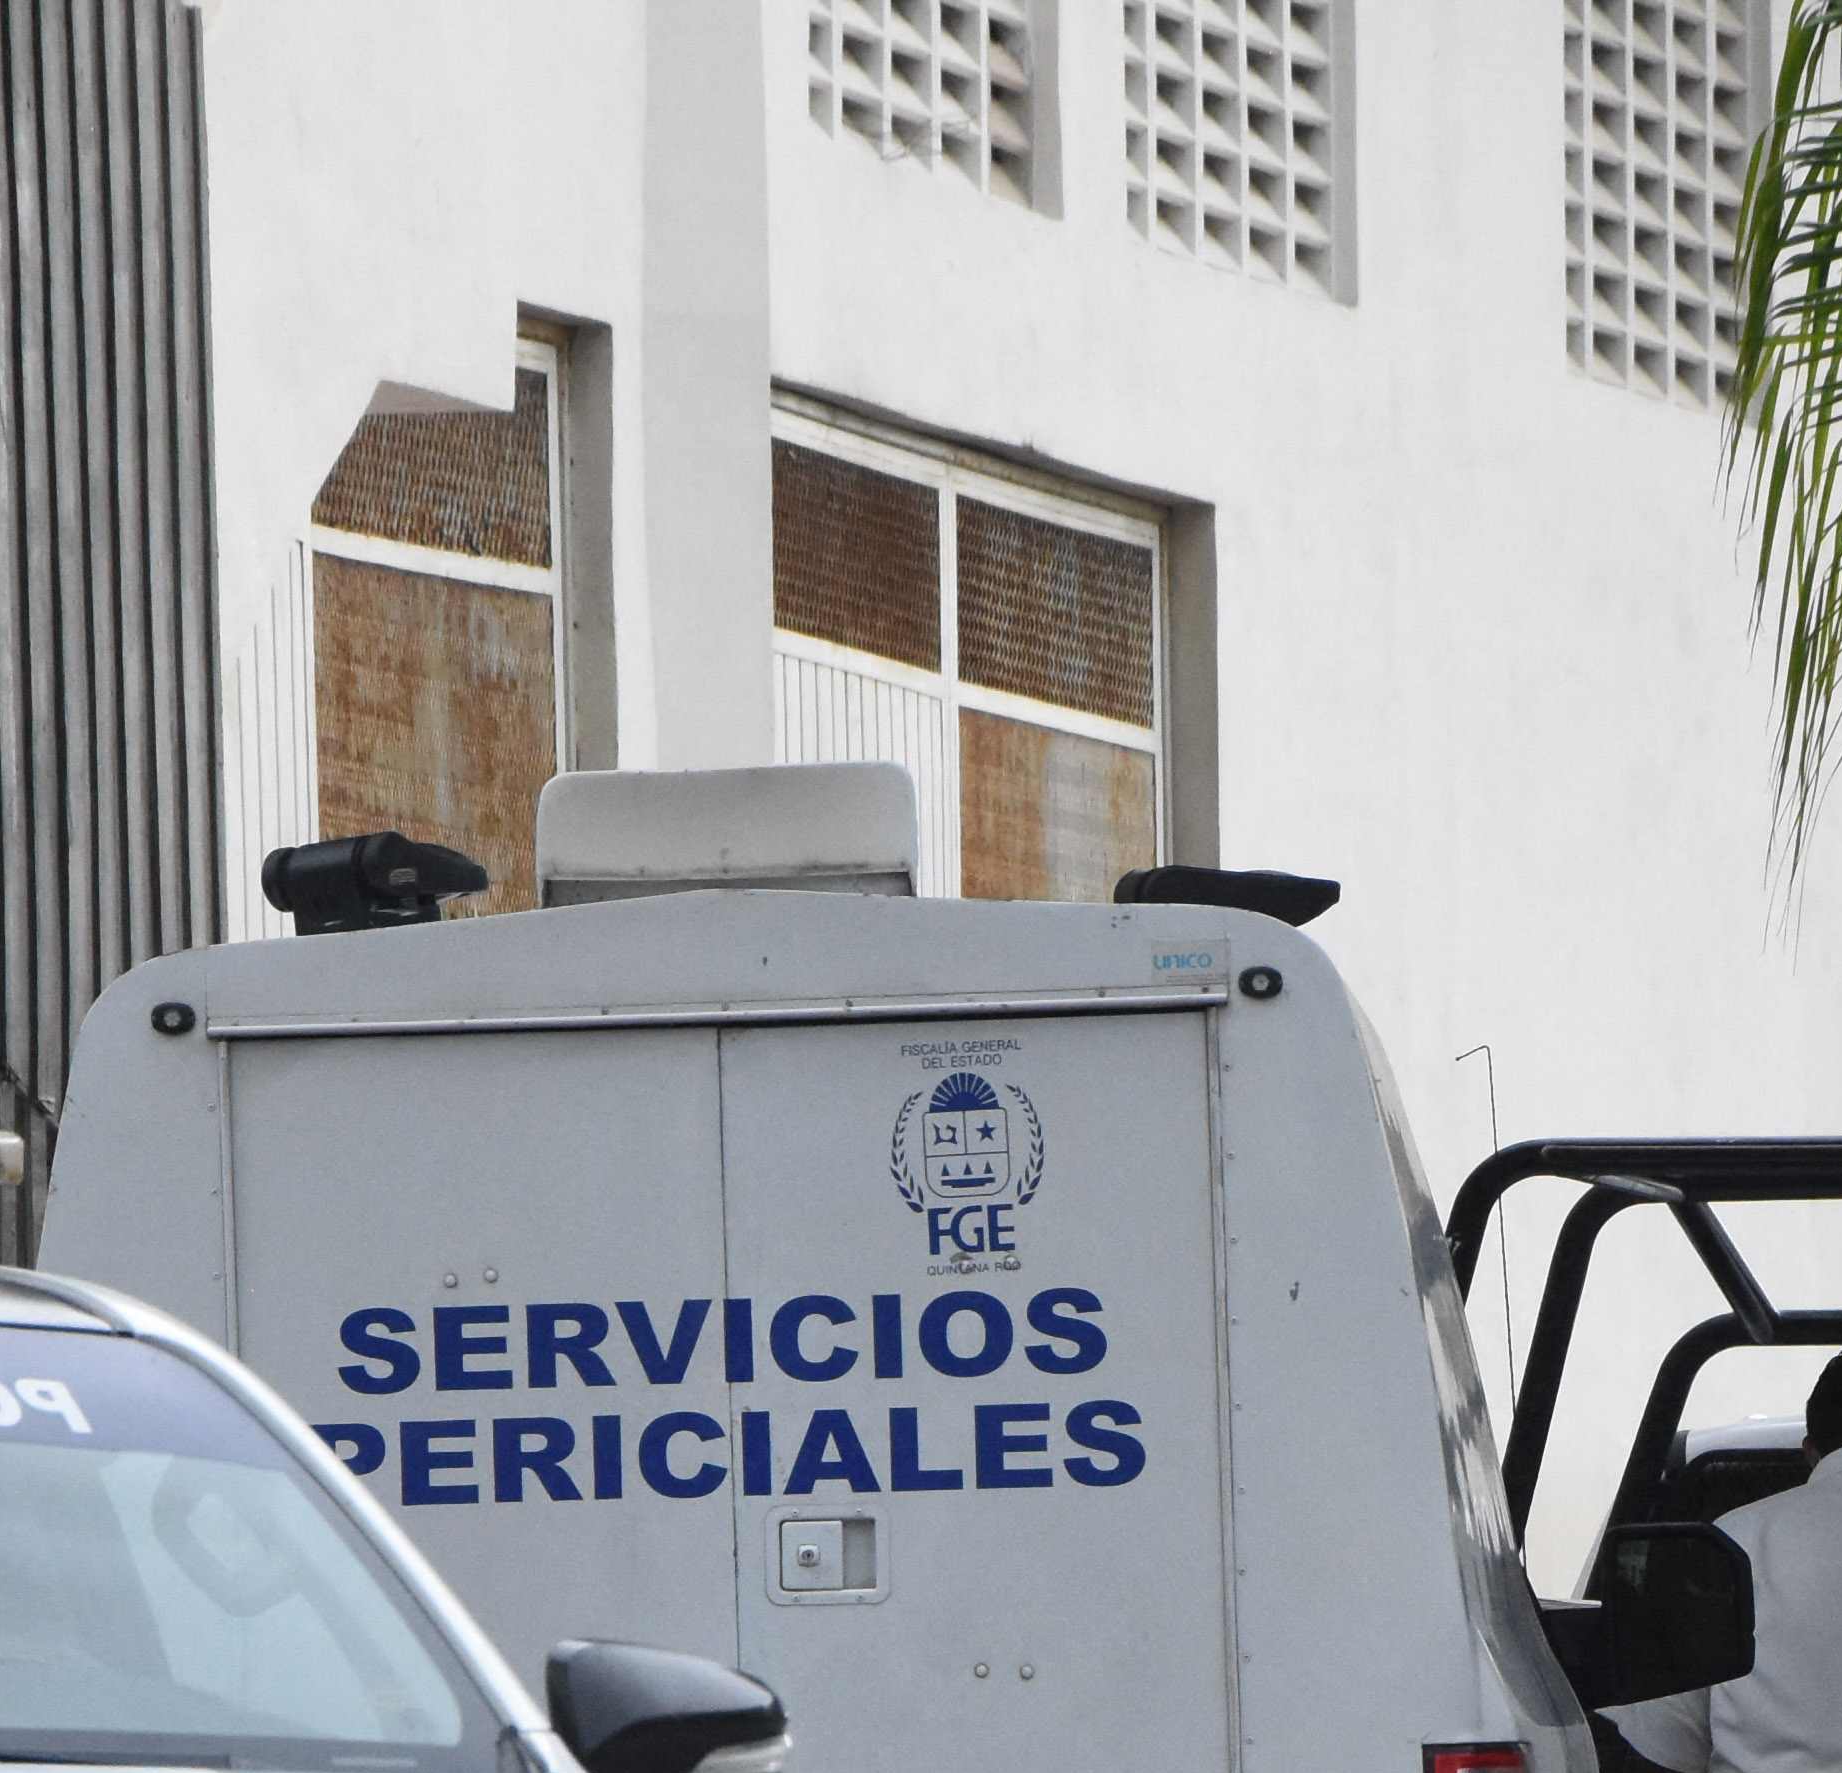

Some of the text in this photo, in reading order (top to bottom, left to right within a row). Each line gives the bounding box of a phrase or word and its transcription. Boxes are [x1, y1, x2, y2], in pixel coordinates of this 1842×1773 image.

[922, 1053, 1002, 1069] DEL ESTADO
[961, 1039, 1021, 1053] GENERAL
[927, 1203, 1016, 1255] FGE
[337, 1287, 1108, 1395] SERVICIOS
[309, 1400, 1147, 1506] PERICIALES
